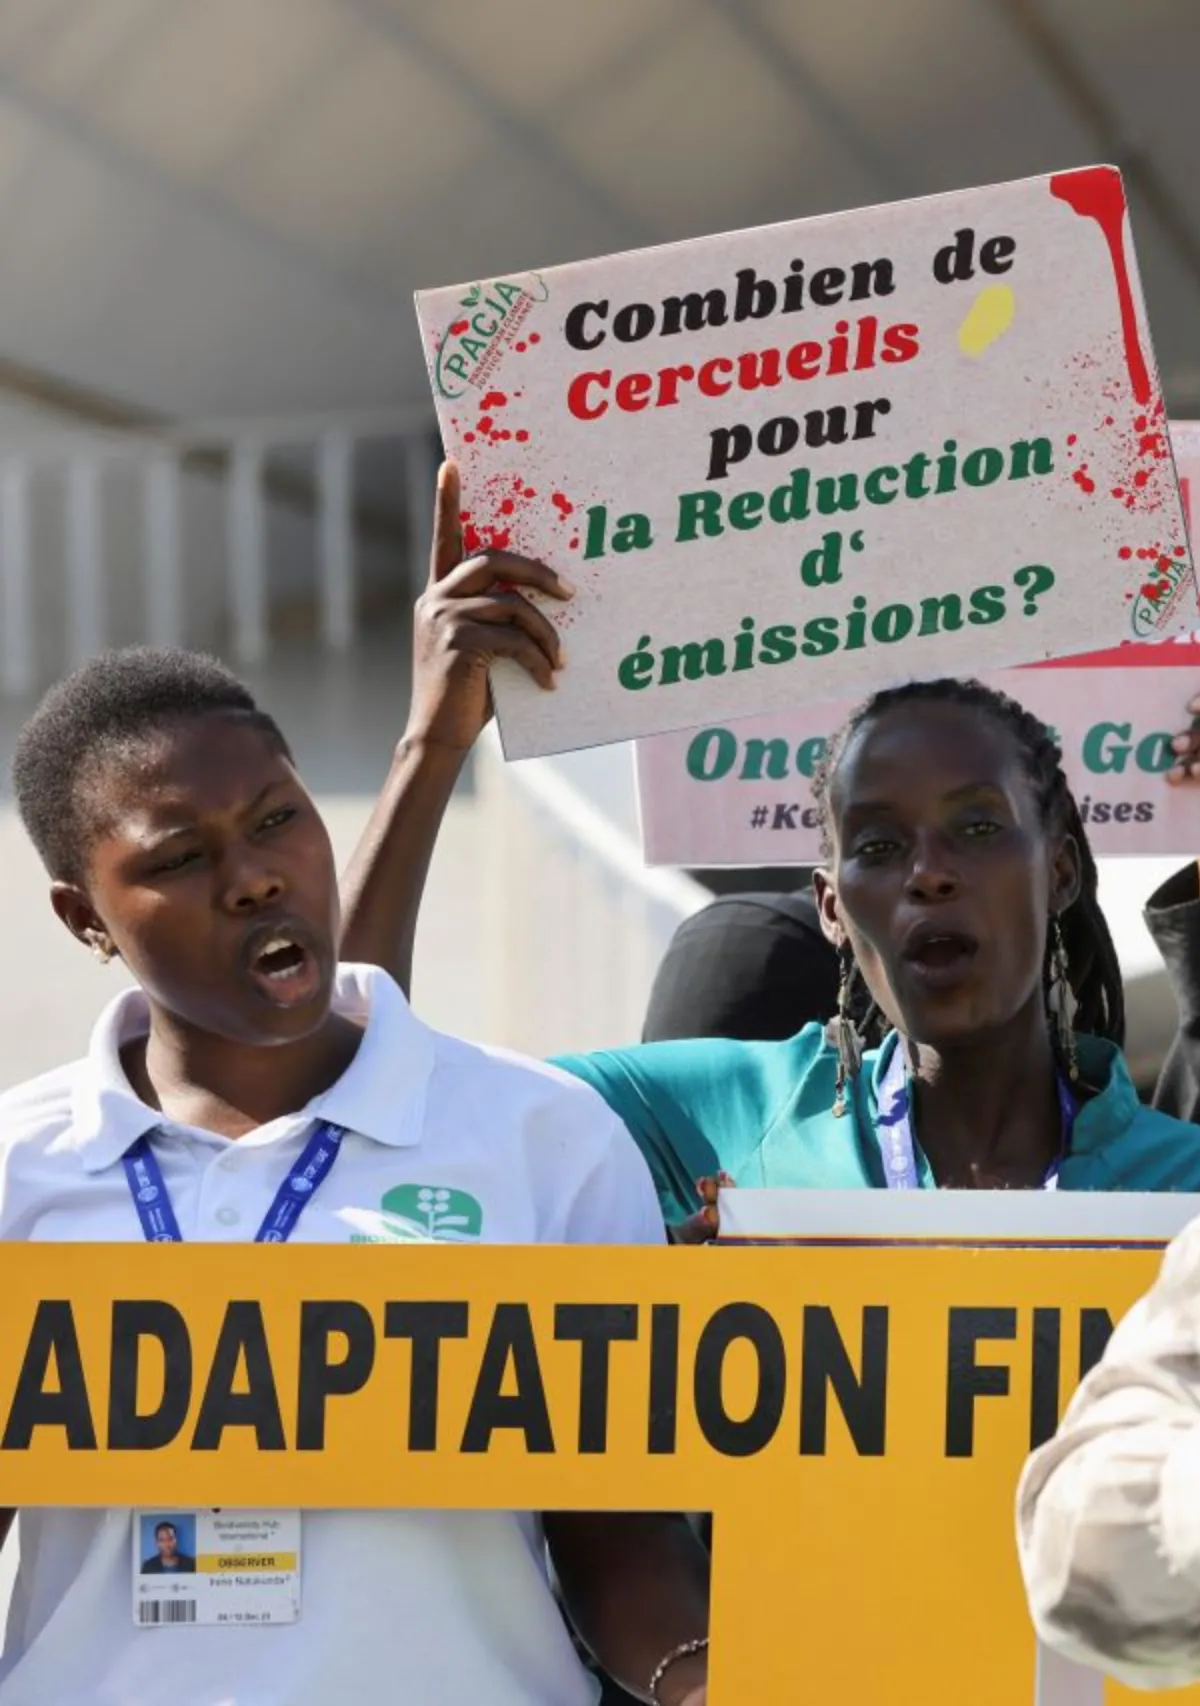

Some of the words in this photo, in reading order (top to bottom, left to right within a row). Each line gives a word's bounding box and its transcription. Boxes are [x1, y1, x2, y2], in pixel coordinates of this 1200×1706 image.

[443, 281, 522, 381] PACJA
[563, 257, 897, 352] Combien
[932, 226, 1017, 286] de
[567, 316, 920, 422] Cercueils
[705, 397, 893, 482] pour
[587, 506, 650, 560] la
[678, 438, 1054, 542] Reduction
[617, 566, 1057, 693] émissions?
[1, 1300, 889, 1457] ADAPTATION
[216, 1556, 278, 1569] OBSERVER
